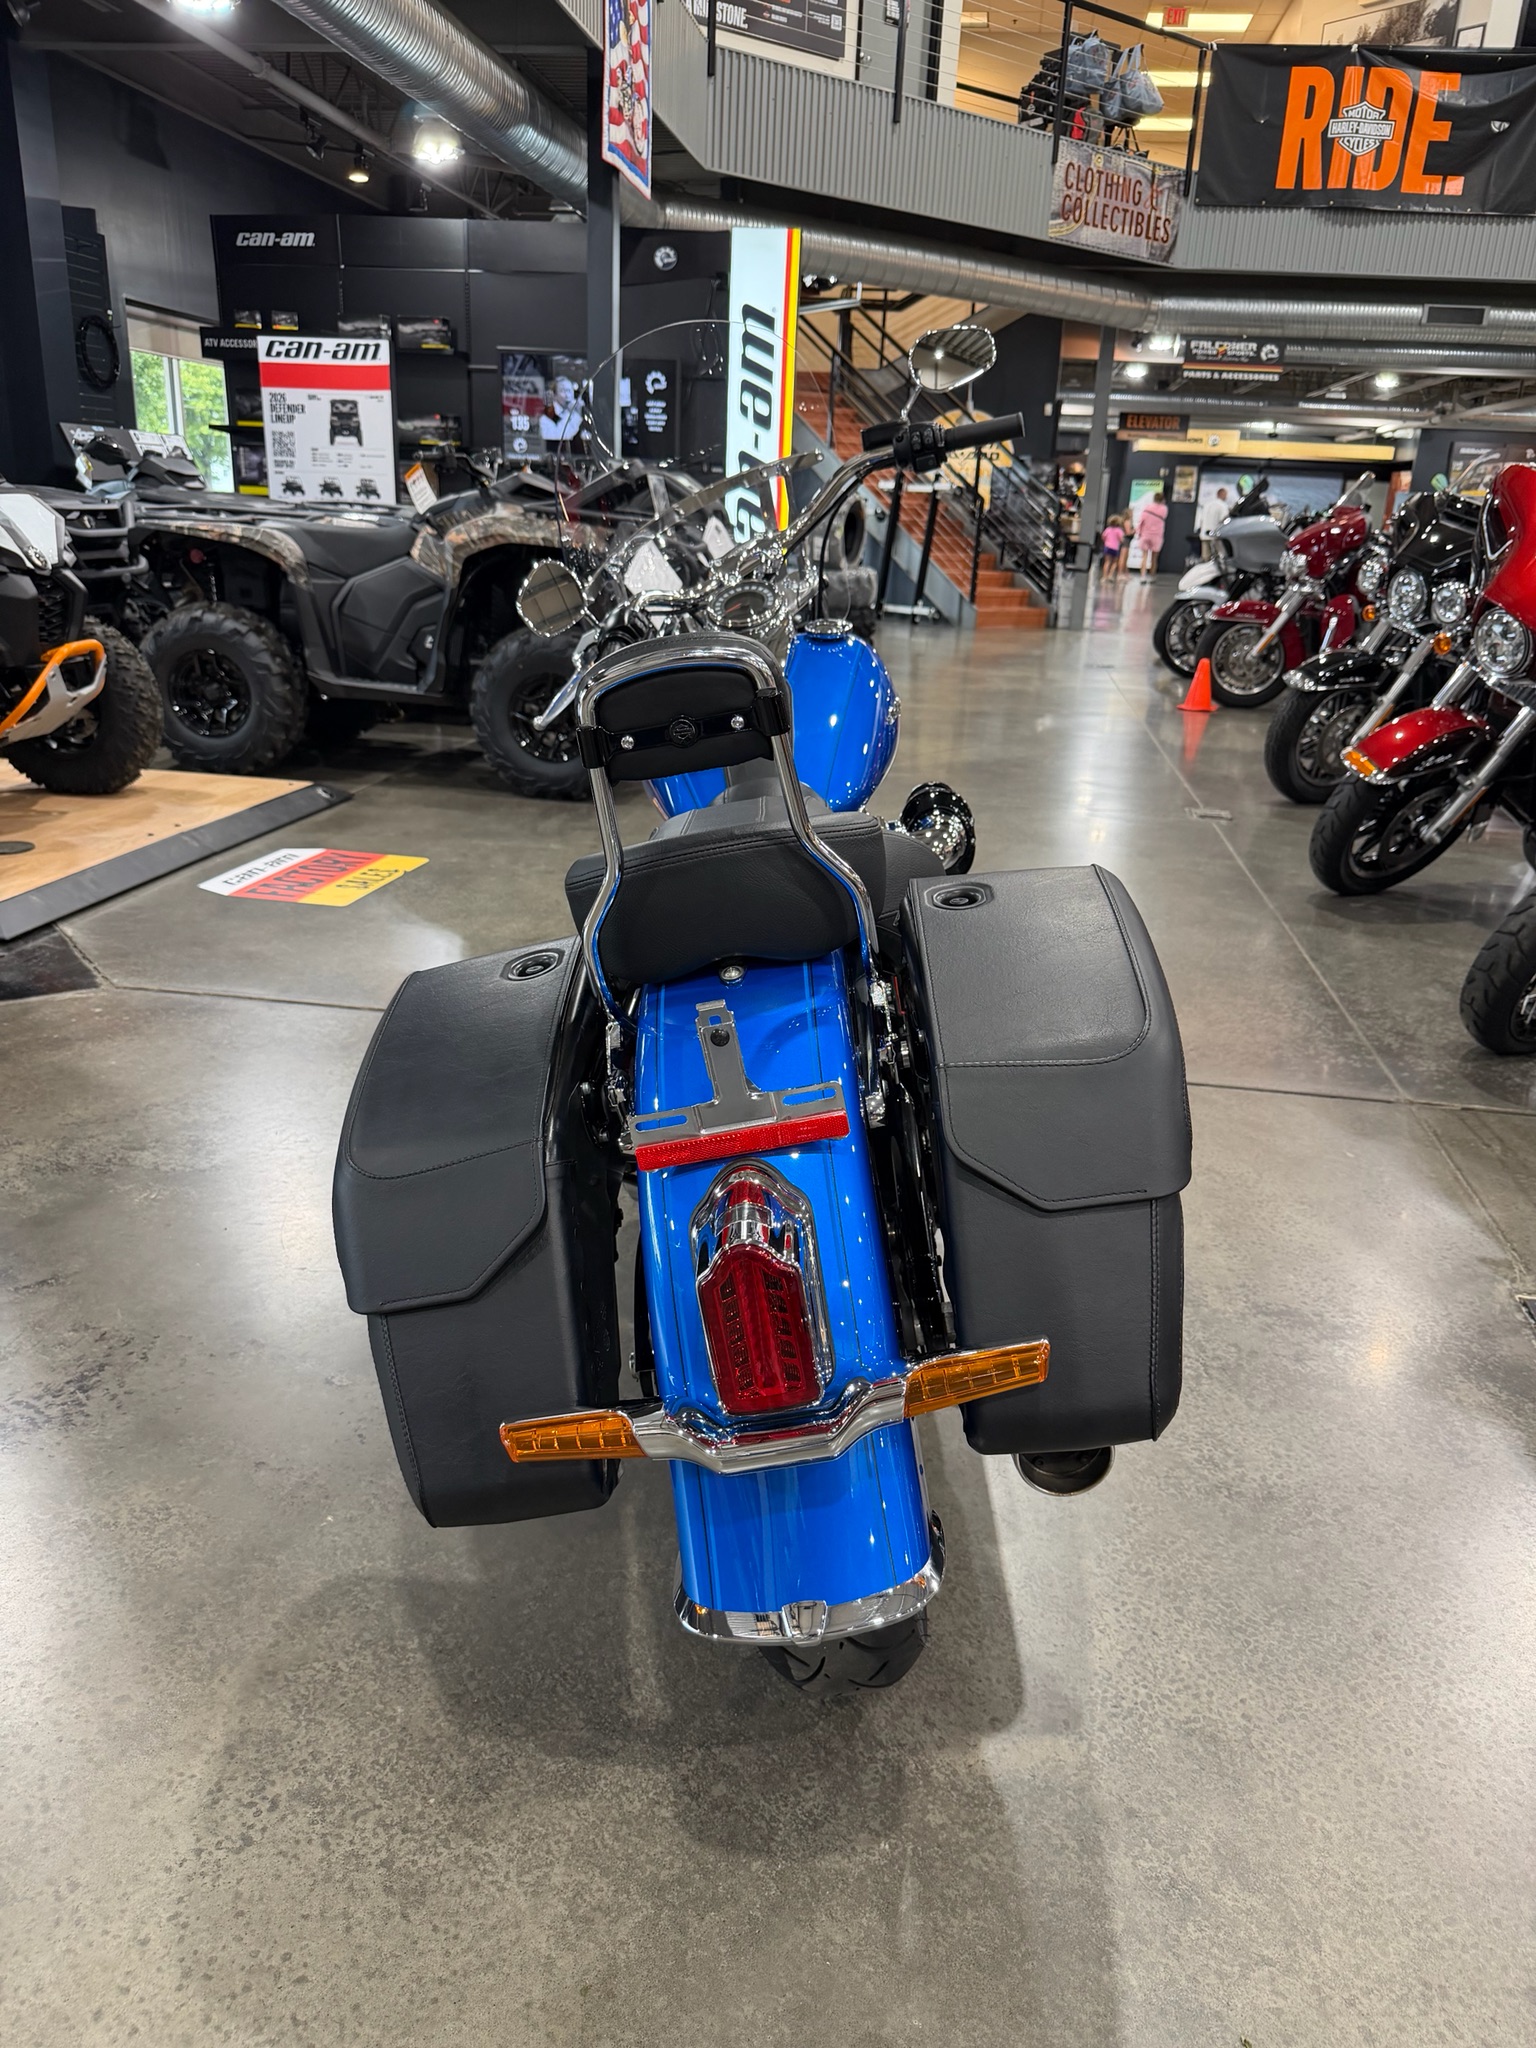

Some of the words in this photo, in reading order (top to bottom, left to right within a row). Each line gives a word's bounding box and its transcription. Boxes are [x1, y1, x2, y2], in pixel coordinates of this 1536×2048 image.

[1167, 7, 1187, 25] EXIT
[1348, 105, 1380, 120] MOTOR
[1275, 66, 1465, 196] RIDE.
[1331, 121, 1392, 136] HARLEY-DAVIDSON
[1343, 137, 1375, 152] CYCLES
[1065, 161, 1143, 207] CLOTHING
[1061, 194, 1171, 243] COLLECTIBLES
[236, 232, 315, 247] can-am
[204, 338, 218, 348] ATV
[265, 340, 381, 361] can-am
[1183, 370, 1212, 379] PARTS
[1213, 371, 1220, 379] &
[1221, 372, 1280, 382] ACCESSORIES
[270, 402, 306, 415] DEFENDER
[271, 414, 296, 425] LINEUP
[1126, 415, 1181, 430] ELEVATOR
[245, 851, 374, 898] FACTORY
